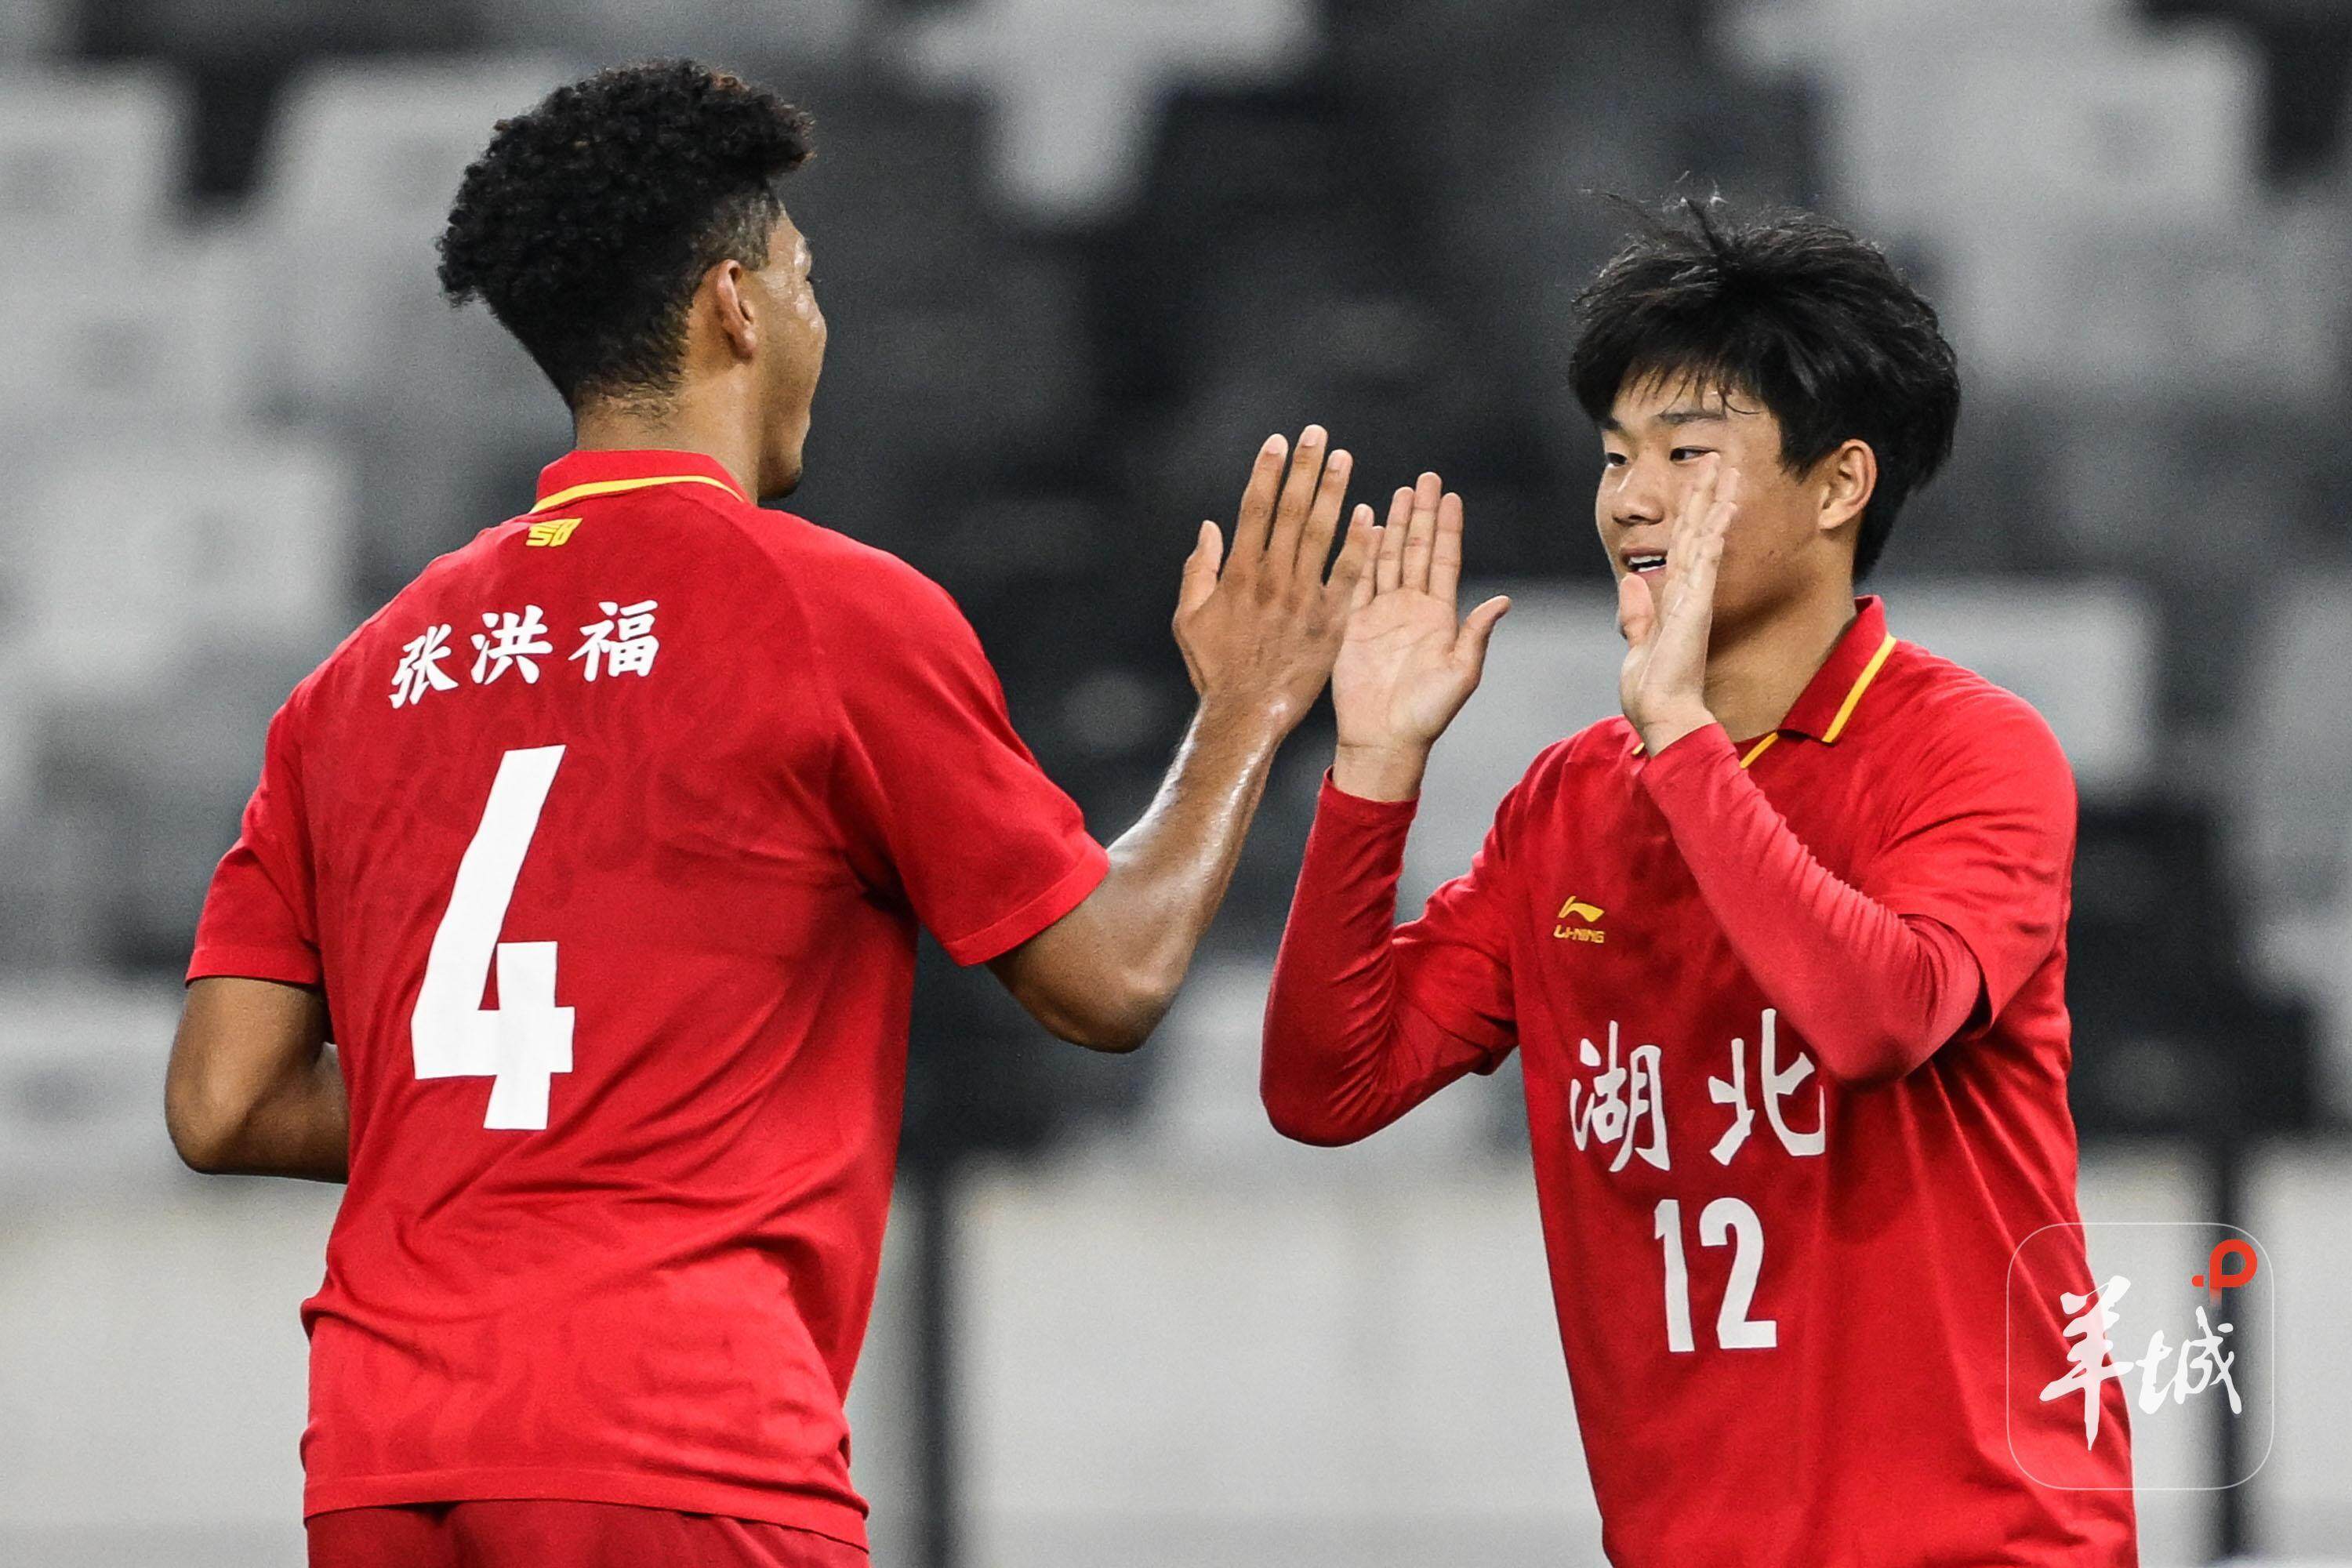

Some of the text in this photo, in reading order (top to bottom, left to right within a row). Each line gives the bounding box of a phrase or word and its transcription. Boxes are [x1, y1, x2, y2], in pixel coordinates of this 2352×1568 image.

[388, 600, 660, 709] 张洪福
[411, 744, 575, 1131] 4
[1570, 1008, 1826, 1172] 湖北
[1653, 1197, 1777, 1352] 12
